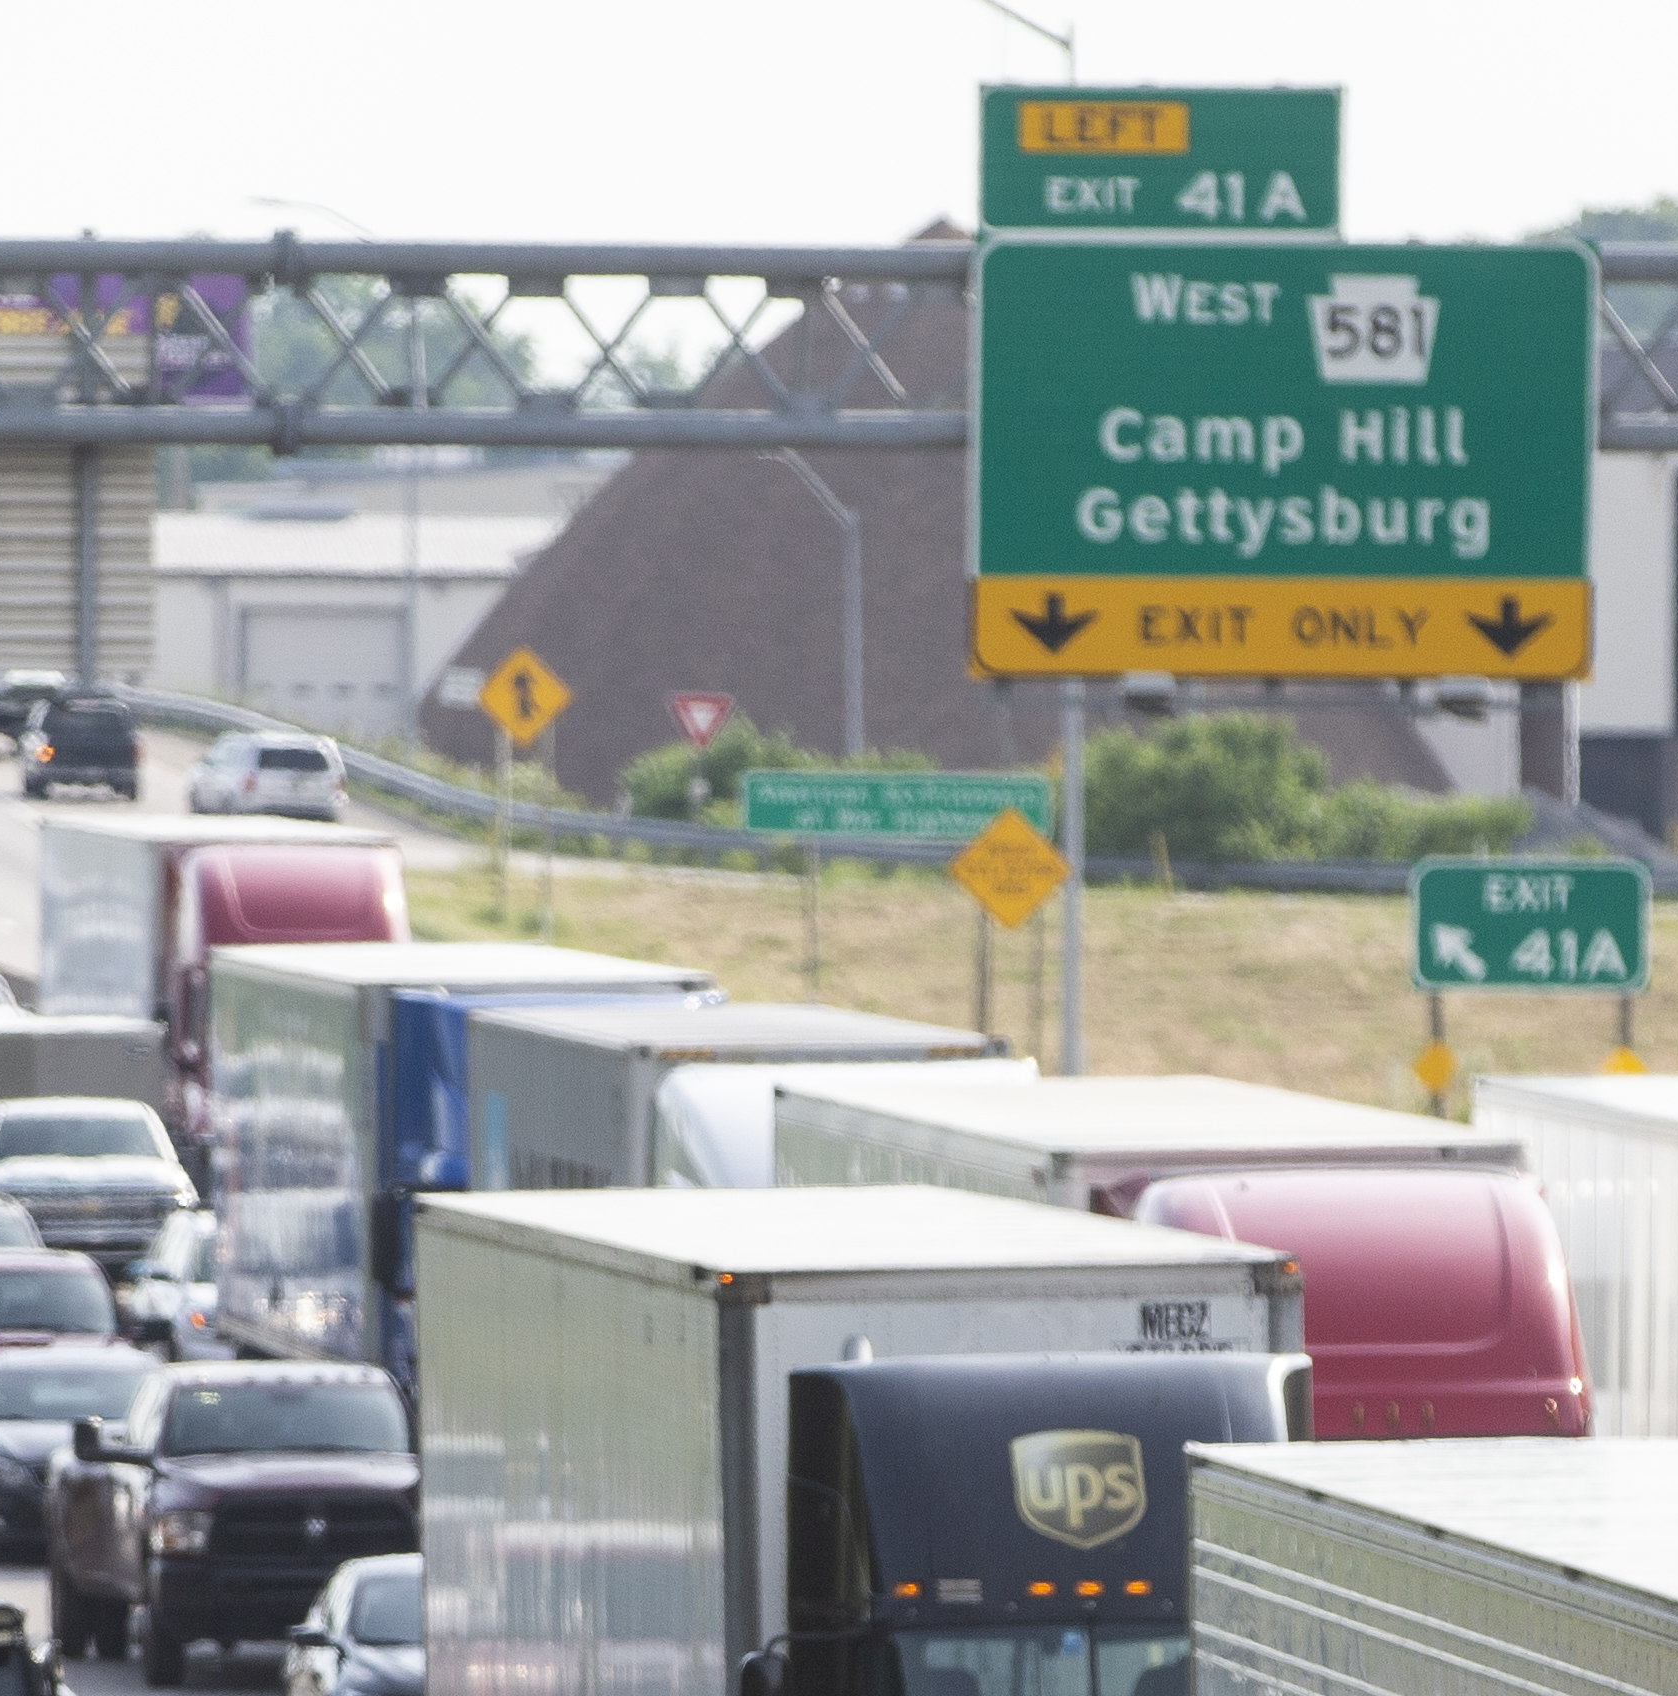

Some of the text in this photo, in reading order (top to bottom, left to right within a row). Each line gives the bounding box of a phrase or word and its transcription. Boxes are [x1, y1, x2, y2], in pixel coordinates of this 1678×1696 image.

[1040, 106, 1165, 144] LEFT
[1045, 171, 1307, 220] EXIT 41A
[1130, 272, 1282, 325] WEST
[1325, 305, 1426, 361] 581
[1099, 406, 1469, 475] Camp Hill
[1076, 486, 1492, 560] Gettysburg
[1137, 605, 1430, 650] EXIT ONLY
[1481, 873, 1574, 914] EXIT
[1508, 926, 1628, 980] 41A
[1026, 1463, 1139, 1529] ups
